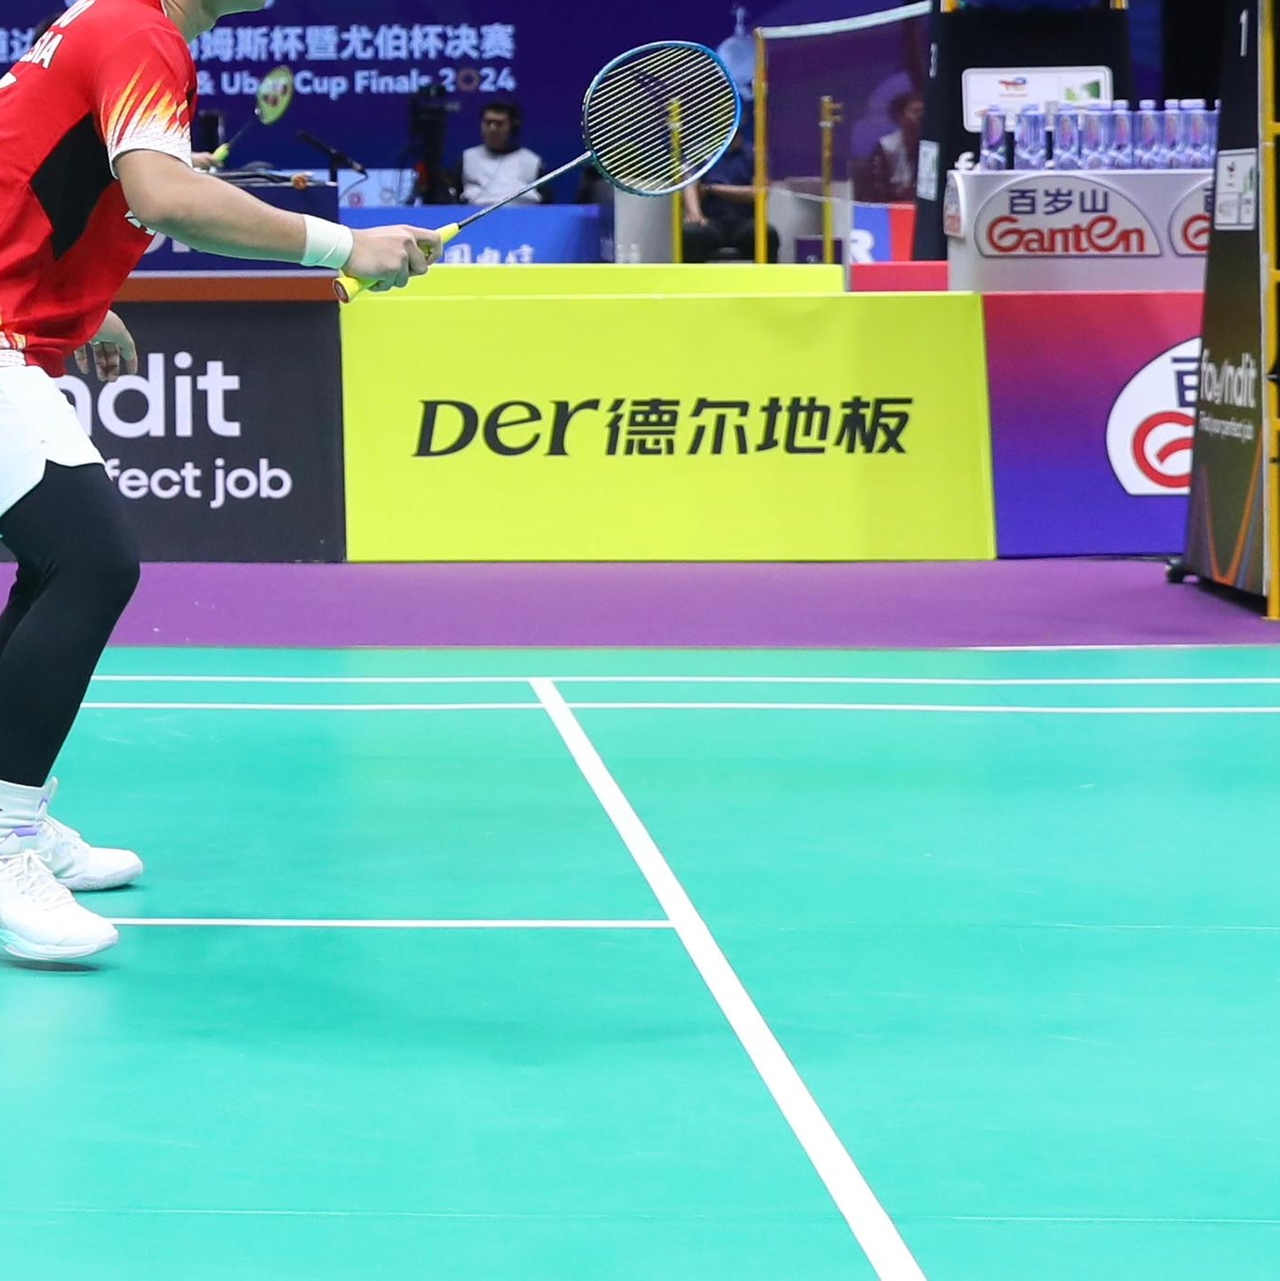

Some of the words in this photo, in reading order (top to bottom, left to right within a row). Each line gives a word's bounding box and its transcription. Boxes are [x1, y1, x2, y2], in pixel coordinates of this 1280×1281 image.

[1239, 9, 1249, 57] 1
[294, 70, 349, 100] Cup
[1008, 188, 1109, 216] 百岁山
[604, 396, 914, 456] 德尔地板
[209, 458, 293, 509] job
